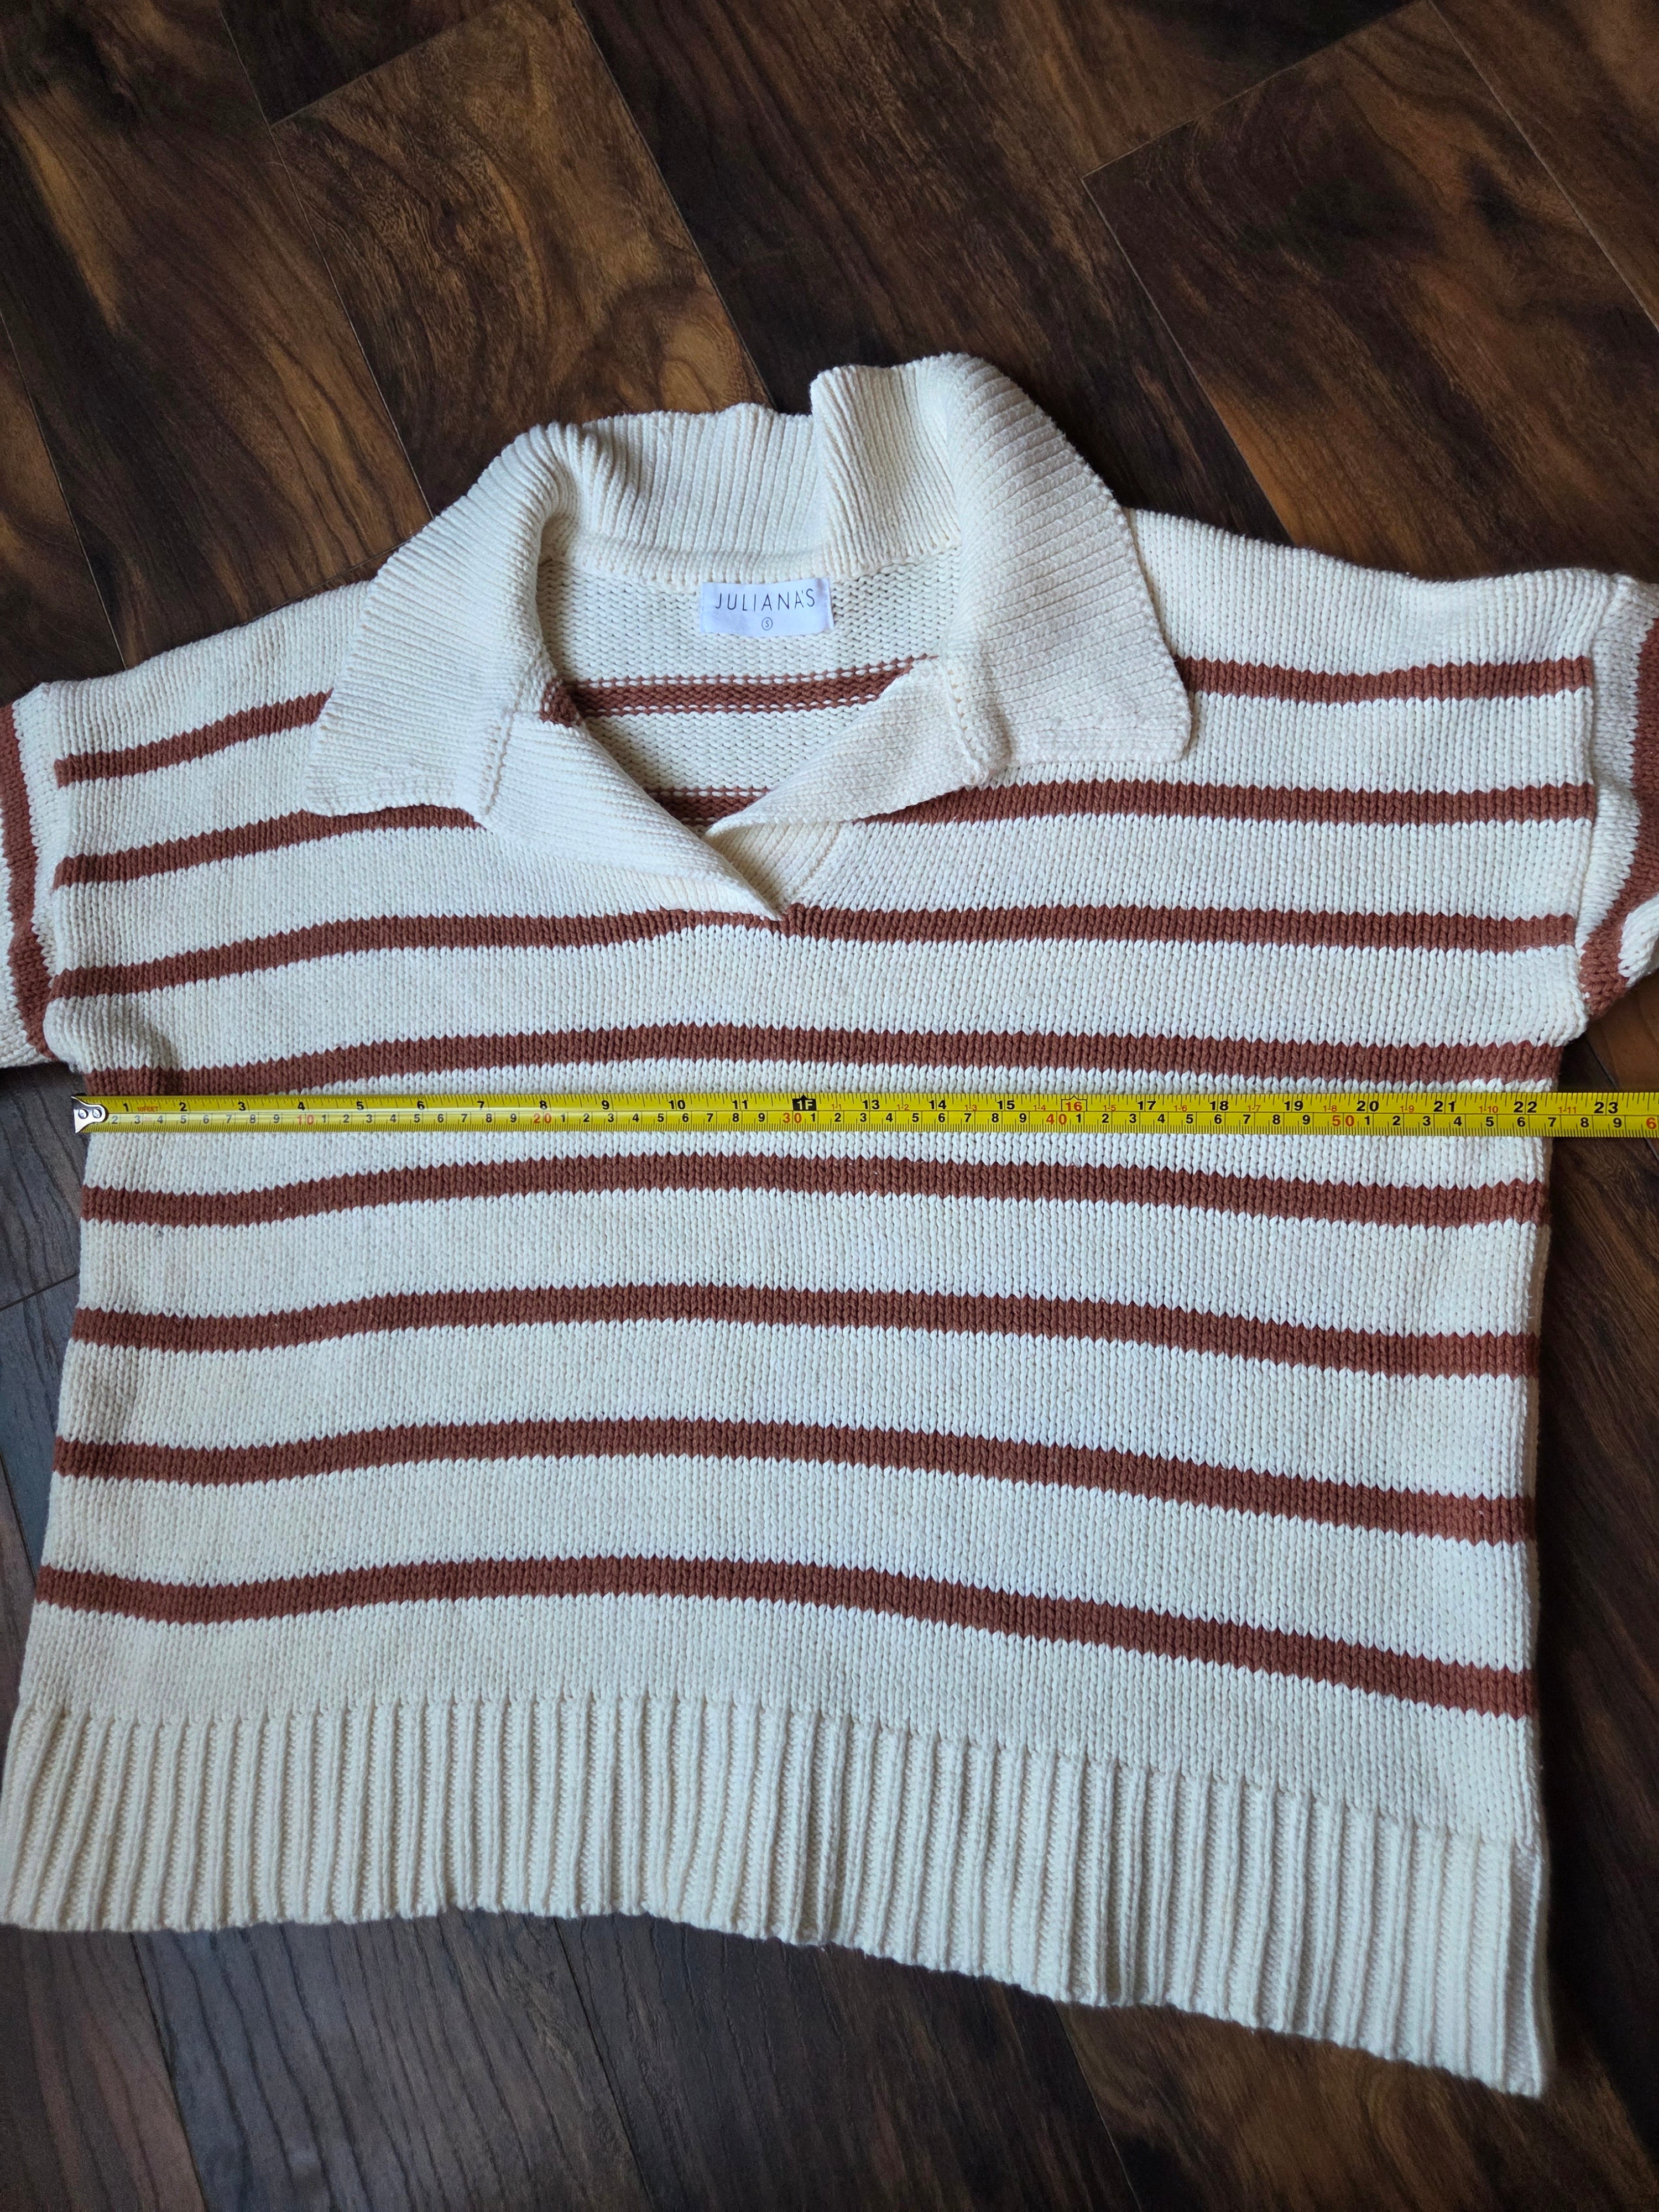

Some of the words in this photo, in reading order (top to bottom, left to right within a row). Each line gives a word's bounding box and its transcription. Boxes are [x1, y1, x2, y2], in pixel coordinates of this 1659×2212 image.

[715, 588, 815, 612] JULIANA'S
[123, 1103, 129, 1112] 1
[179, 1102, 187, 1112] 2
[238, 1102, 246, 1111] 3
[298, 1102, 305, 1110] 4
[356, 1102, 364, 1110] 5
[417, 1100, 425, 1110] 6
[477, 1101, 484, 1110] 7
[539, 1100, 547, 1110] 8
[602, 1100, 609, 1109] 9
[669, 1100, 686, 1109] 10
[732, 1100, 748, 1109] 11
[797, 1100, 812, 1109] 1F
[863, 1099, 879, 1109] 13
[929, 1100, 946, 1109] 14
[997, 1100, 1015, 1110] 15
[1065, 1102, 1082, 1112] 16
[1138, 1100, 1156, 1110] 17
[1210, 1100, 1228, 1111] 18
[1284, 1100, 1303, 1111] 19
[1357, 1100, 1379, 1112] 20
[1433, 1100, 1455, 1112] 21
[1514, 1101, 1537, 1113] 22
[1594, 1102, 1618, 1114] 23
[134, 1115, 140, 1124] 3
[157, 1115, 163, 1124] 4
[250, 1114, 256, 1123] 8
[274, 1114, 280, 1123] 9
[298, 1115, 314, 1125] 10
[343, 1114, 349, 1123] 2
[366, 1114, 372, 1123] 3
[390, 1114, 396, 1123] 4
[414, 1114, 420, 1123] 5
[437, 1114, 444, 1123] 6
[461, 1114, 467, 1123] 7
[486, 1114, 492, 1123] 8
[510, 1114, 517, 1123] 9
[534, 1114, 551, 1123] 20
[561, 1114, 565, 1122] 1
[583, 1114, 589, 1122] 2
[608, 1113, 614, 1122] 3
[632, 1113, 639, 1122] 4
[658, 1113, 664, 1122] 5
[682, 1113, 688, 1122] 6
[707, 1113, 713, 1122] 7
[733, 1113, 739, 1122] 8
[758, 1113, 765, 1122] 9
[782, 1113, 802, 1123] 30
[811, 1113, 815, 1122] 1
[834, 1113, 841, 1122] 2
[860, 1113, 867, 1122] 3
[886, 1113, 893, 1122] 4
[912, 1113, 919, 1122] 5
[938, 1113, 945, 1122] 6
[964, 1113, 972, 1122] 7
[992, 1113, 999, 1123] 8
[1019, 1113, 1026, 1123] 9
[1046, 1114, 1067, 1124] 40
[1076, 1114, 1081, 1123] 1
[1102, 1114, 1109, 1123] 2
[1129, 1114, 1136, 1123] 3
[1157, 1114, 1165, 1123] 4
[1186, 1114, 1193, 1124] 5
[1214, 1114, 1222, 1124] 6
[1243, 1115, 1251, 1124] 7
[1272, 1115, 1280, 1124] 8
[1302, 1115, 1310, 1124] 9
[1332, 1115, 1354, 1127] 50
[1365, 1115, 1370, 1125] 1
[1392, 1116, 1400, 1125] 2
[1423, 1116, 1431, 1126] 3
[1454, 1117, 1462, 1126] 4
[1486, 1117, 1493, 1126] 5
[1517, 1117, 1525, 1127] 6
[1548, 1118, 1556, 1127] 7
[1580, 1118, 1589, 1128] 8
[1613, 1118, 1622, 1128] 9
